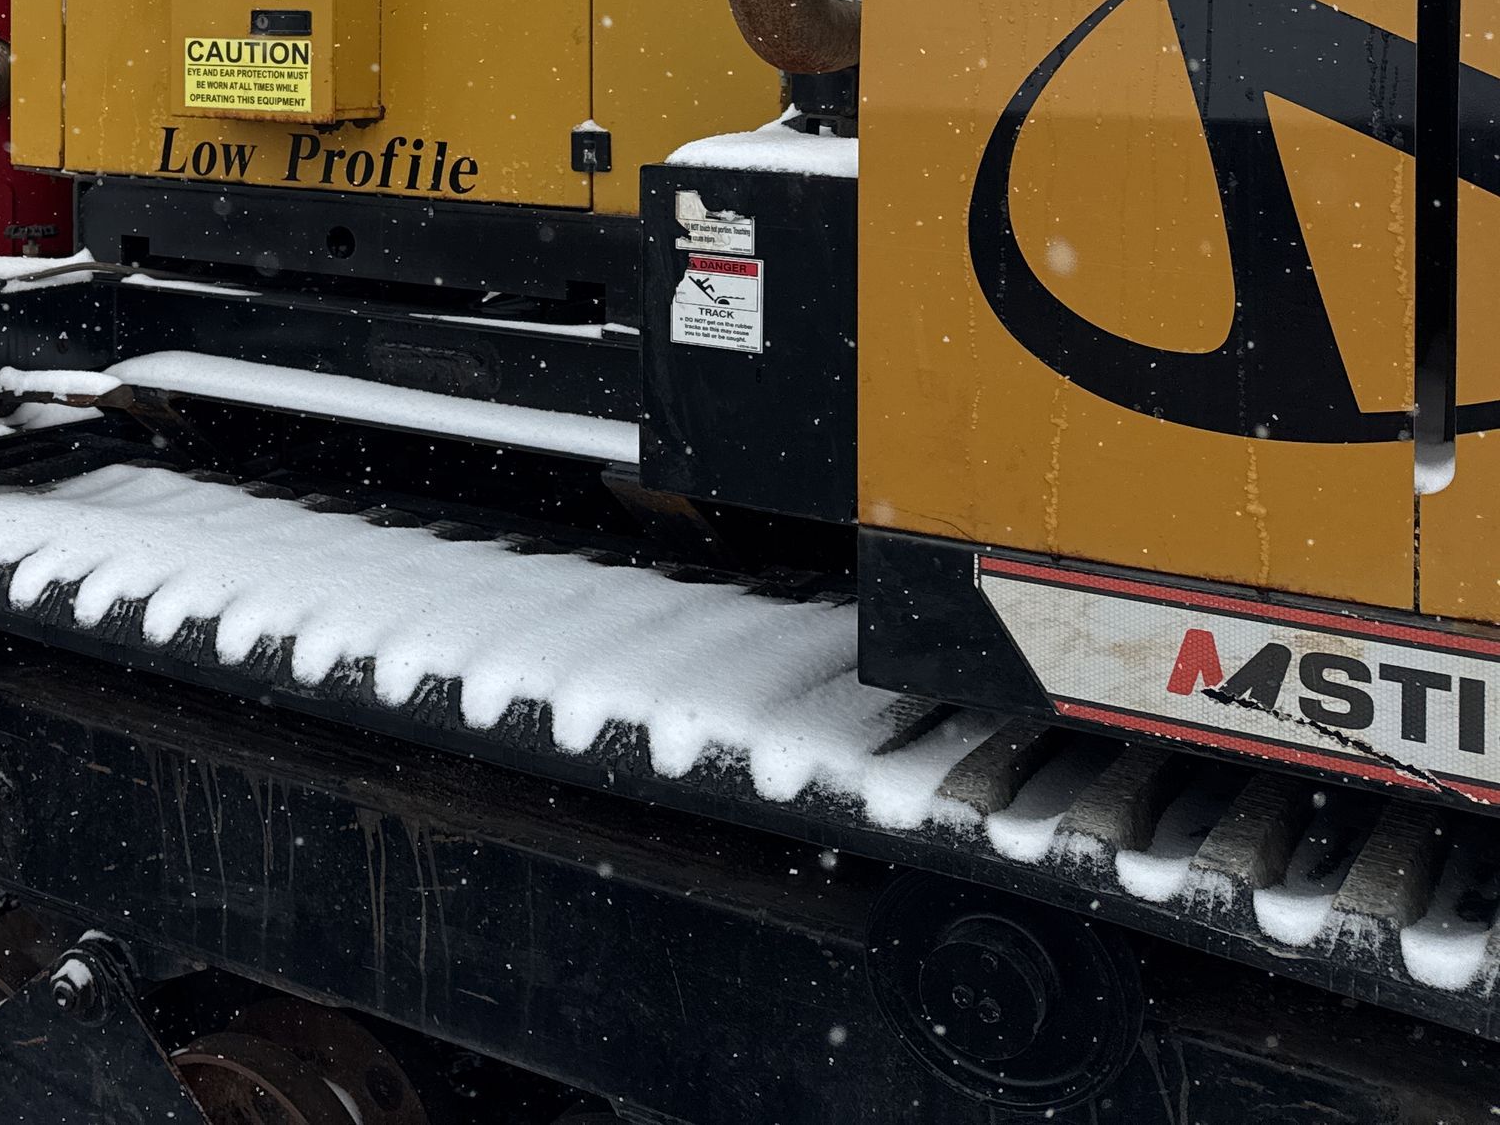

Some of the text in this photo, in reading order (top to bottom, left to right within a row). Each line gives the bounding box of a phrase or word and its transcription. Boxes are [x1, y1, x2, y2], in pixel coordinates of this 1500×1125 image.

[187, 40, 310, 65] CAUTION
[187, 68, 309, 80] EYE AND EAR PROTECTION MUST
[196, 80, 298, 93] BE WORN AT ALL TIMES WHILE
[189, 93, 306, 106] OPERATING THIS EQUIPMENT
[154, 126, 479, 195] Low Profile
[700, 261, 747, 273] DANGER
[698, 307, 735, 319] TRACK
